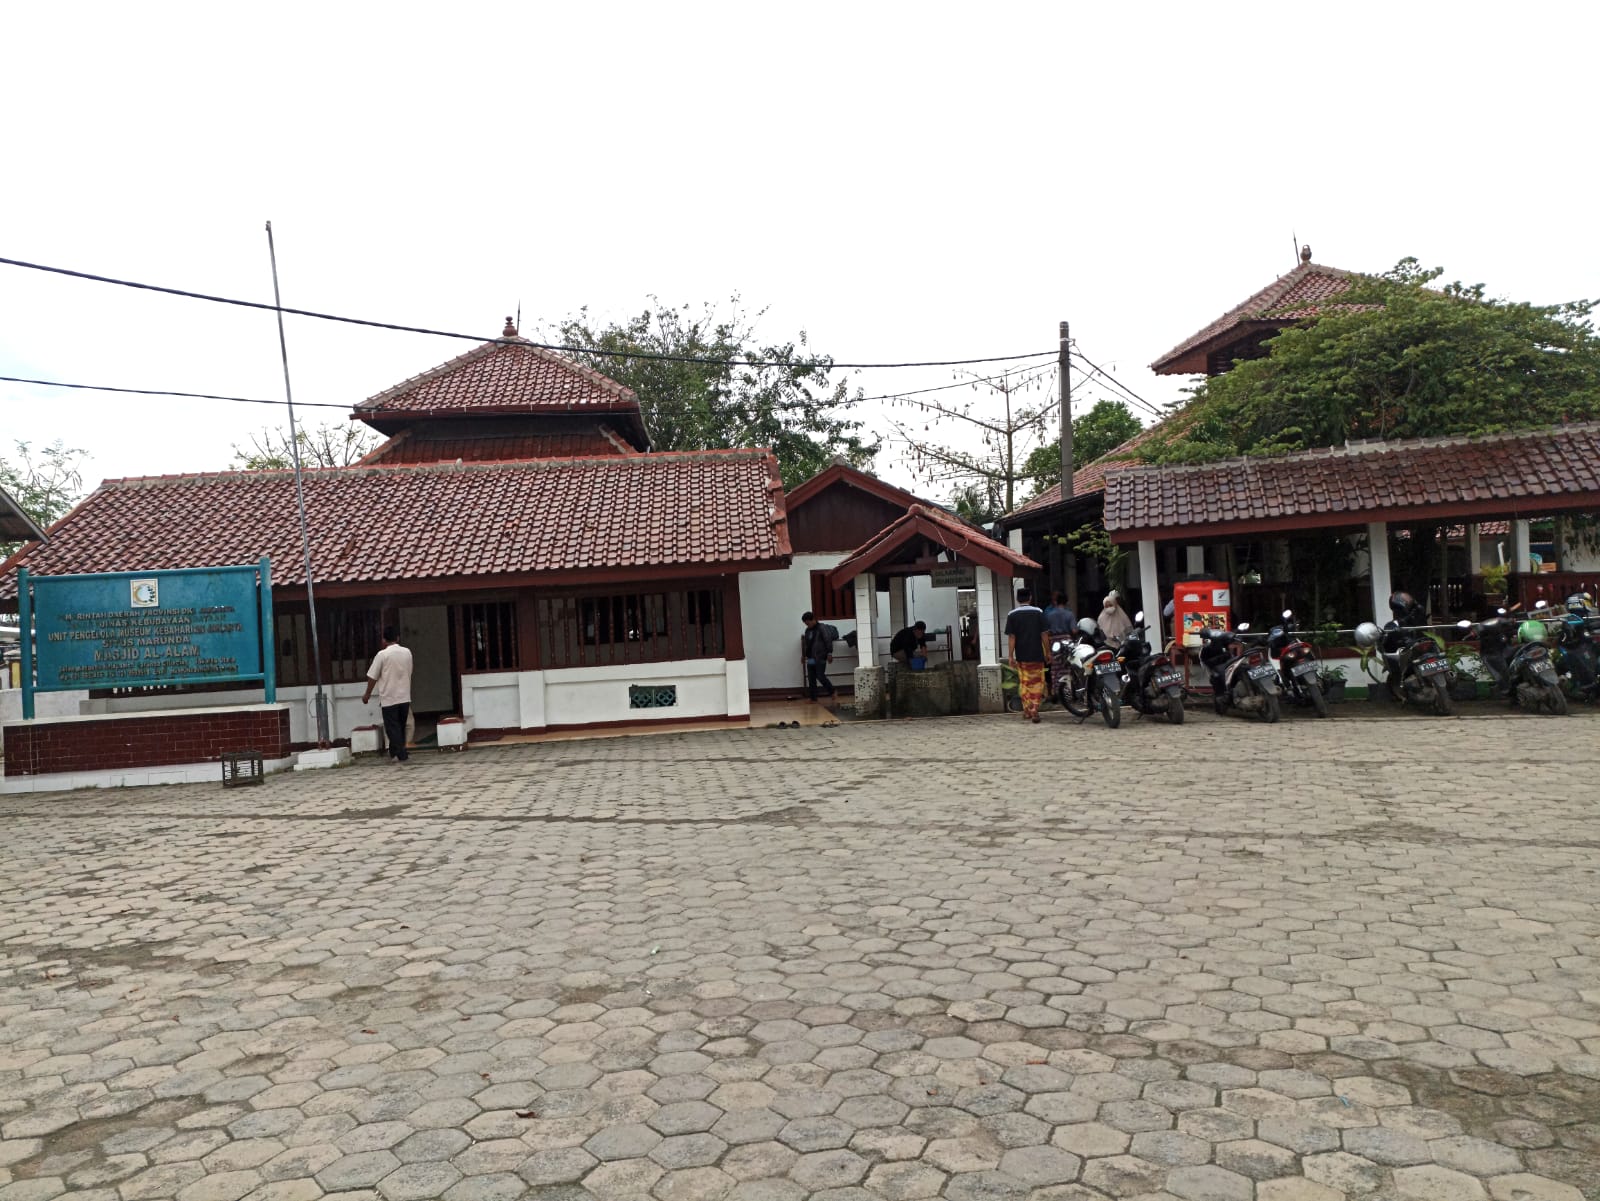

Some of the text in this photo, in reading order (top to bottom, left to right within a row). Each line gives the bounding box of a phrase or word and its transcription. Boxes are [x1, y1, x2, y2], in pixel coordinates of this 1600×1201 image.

[57, 612, 106, 622] MRINTAH
[48, 632, 67, 642] UNIT
[119, 627, 152, 638] MUSEUM
[137, 636, 190, 647] MARUNDA
[94, 648, 140, 662] MASJID
